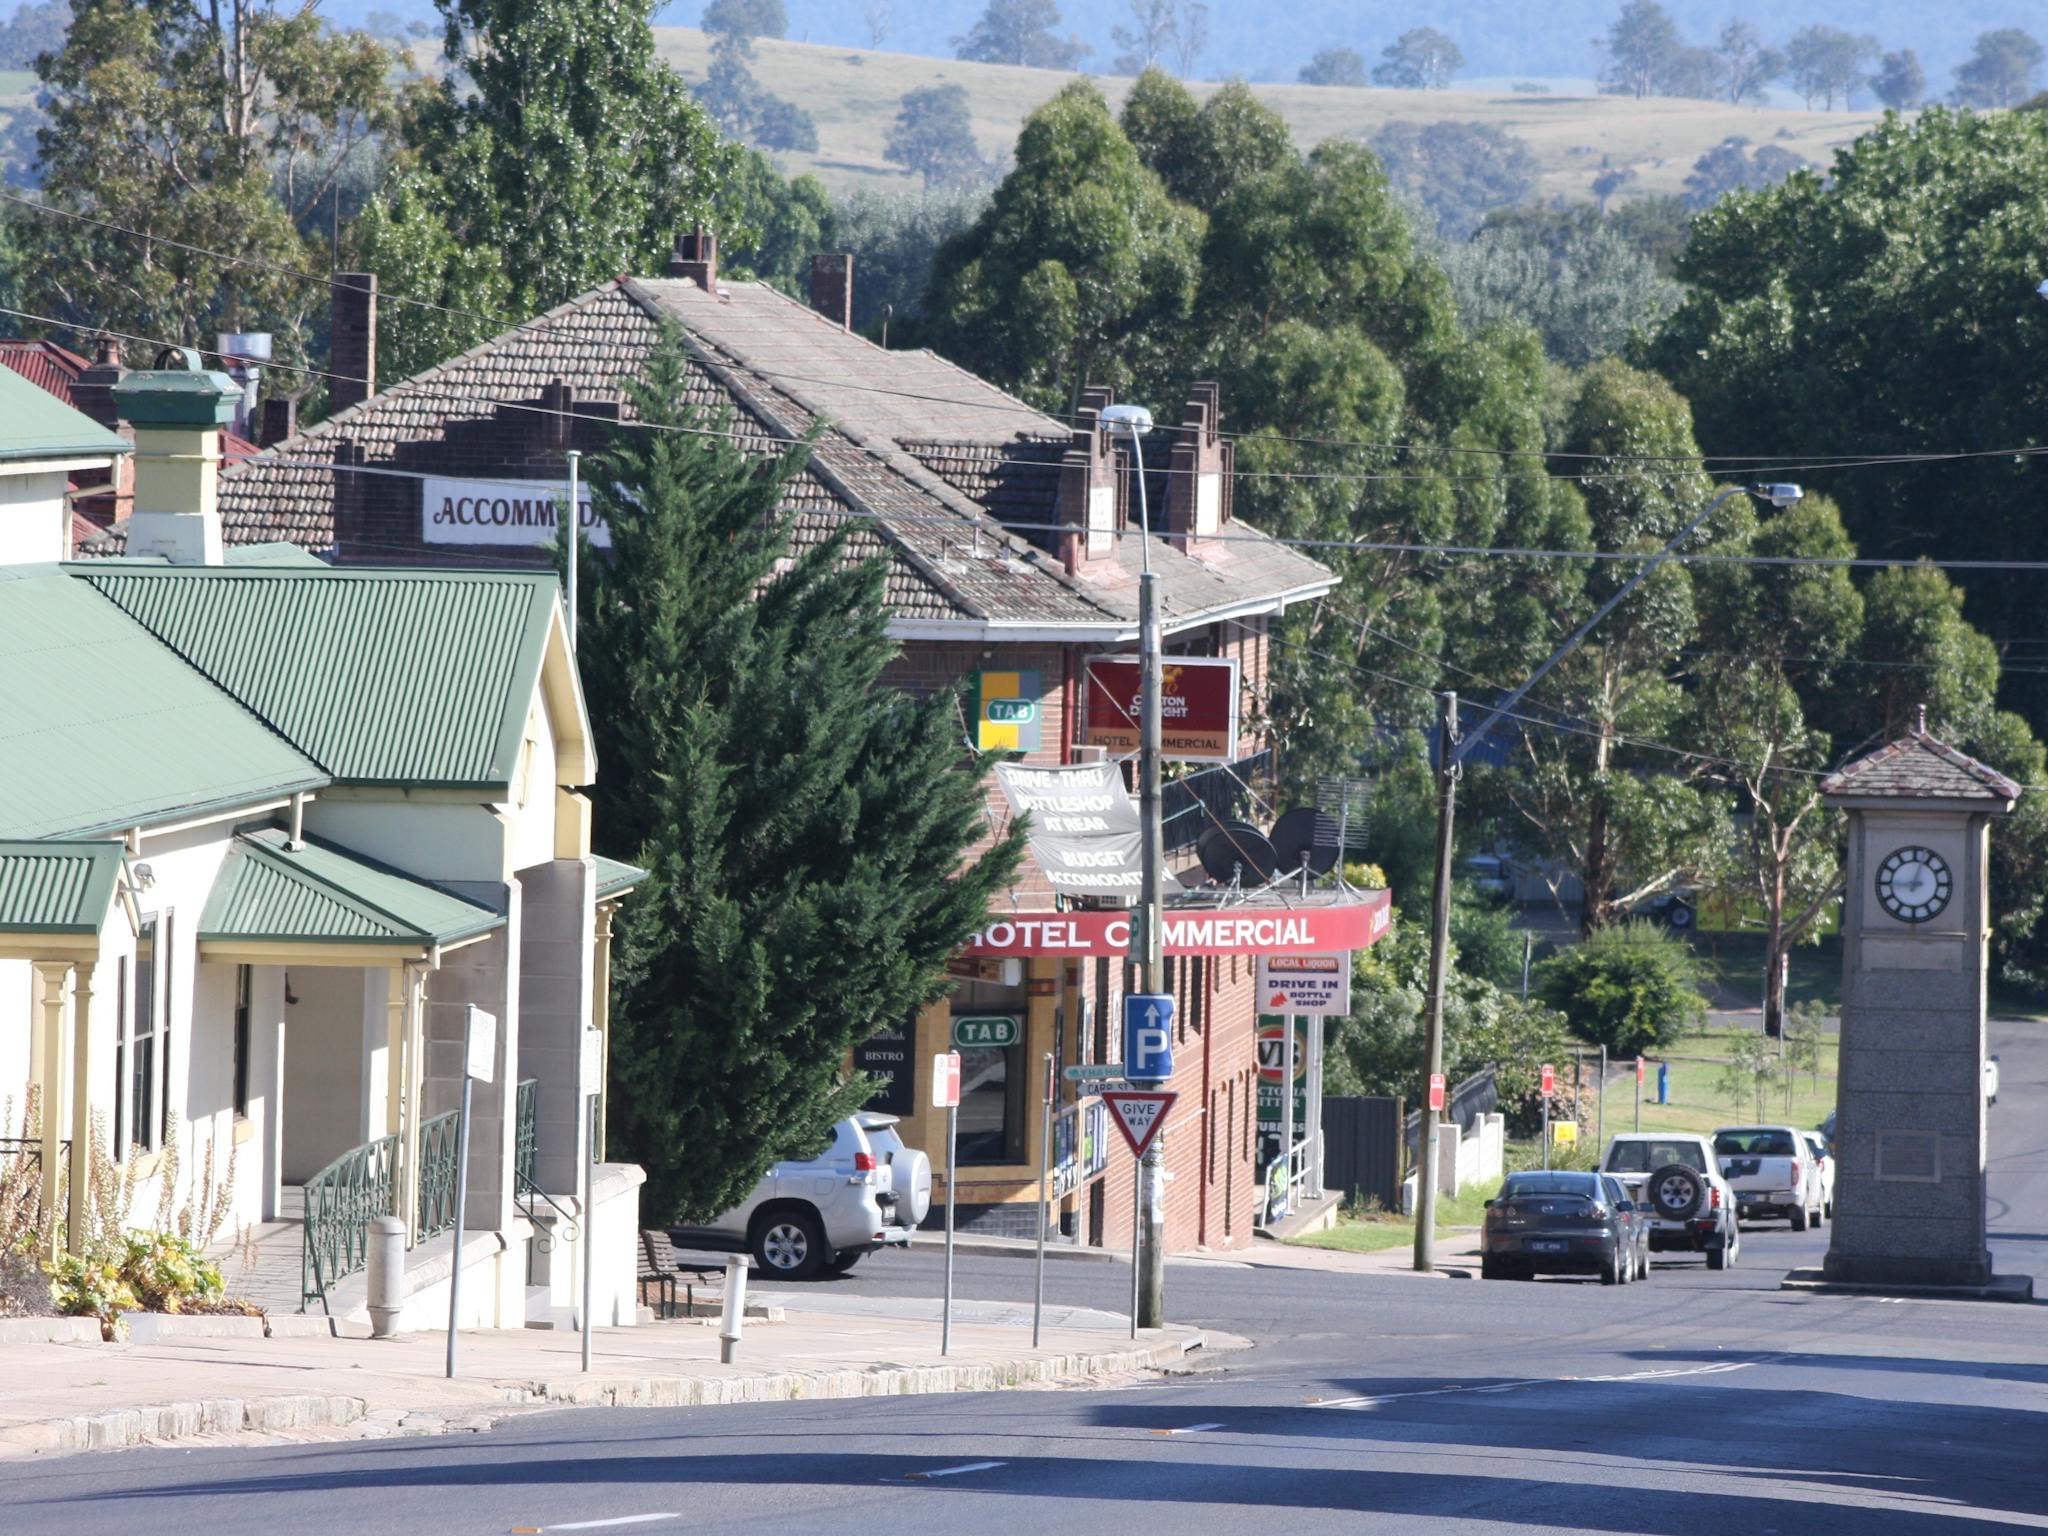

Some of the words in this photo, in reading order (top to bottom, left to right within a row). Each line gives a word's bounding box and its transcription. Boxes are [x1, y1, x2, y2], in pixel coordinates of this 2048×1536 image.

[433, 497, 602, 528] ACCOMMD
[1132, 694, 1185, 706] CTON
[993, 704, 1028, 719] TAB
[1129, 704, 1188, 717] DGHT
[1094, 735, 1133, 746] HOTEL
[1005, 769, 1051, 788] DRIVE
[1059, 769, 1104, 788] THRU
[1015, 793, 1114, 812] BOTTLESHOP
[1044, 816, 1062, 832] AT
[1062, 816, 1110, 832] REAR
[1061, 850, 1125, 868] BUDGET
[1045, 867, 1175, 887] ACCOMODATN
[1105, 918, 1315, 948] CMMERCIAL
[1272, 957, 1298, 967] LOCAL
[1302, 958, 1337, 968] LIQUOR
[1268, 980, 1316, 989] DRIVE
[1322, 981, 1338, 989] IN
[965, 1023, 1008, 1040] TAB
[1137, 1028, 1167, 1069] P
[865, 1051, 904, 1061] BISTRO
[873, 1070, 894, 1079] TAB
[1122, 1103, 1156, 1115] GIVE
[1259, 1097, 1300, 1108] ITTR
[1128, 1117, 1151, 1126] WAY
